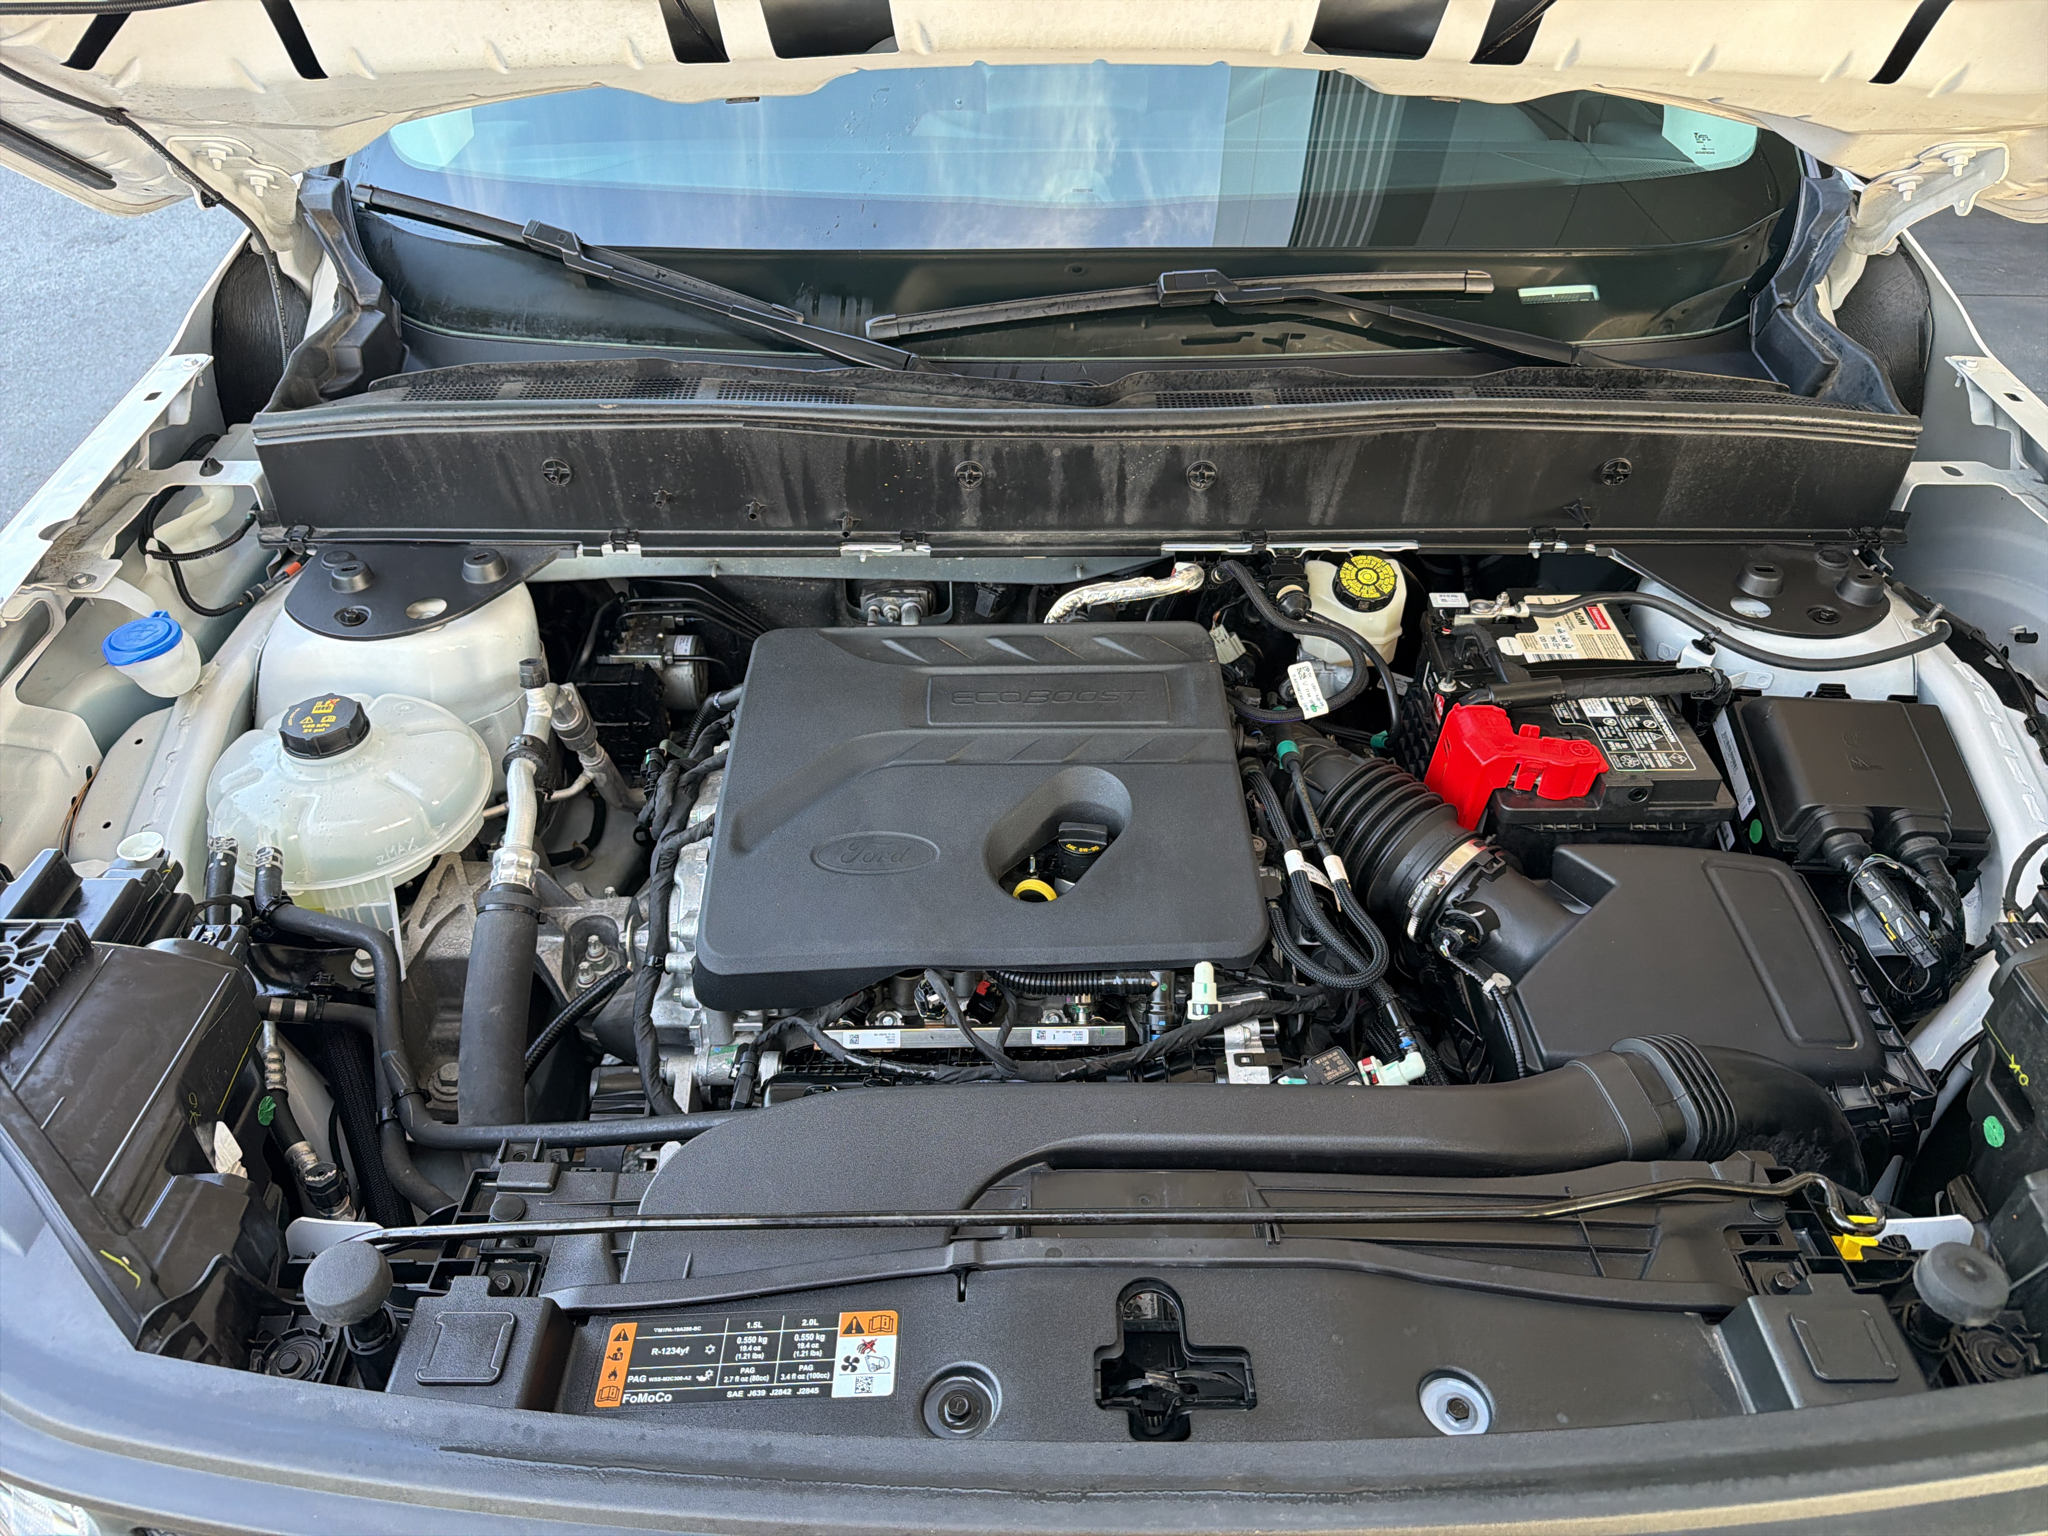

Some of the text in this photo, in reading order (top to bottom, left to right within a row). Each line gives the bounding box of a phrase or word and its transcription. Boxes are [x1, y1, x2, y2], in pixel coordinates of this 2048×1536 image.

[1573, 611, 1588, 626] AGM
[384, 836, 420, 860] MAX
[840, 841, 911, 864] Ford
[746, 1321, 763, 1329] 1.5L
[801, 1318, 819, 1326] 2.0L
[736, 1335, 768, 1345] 0.550 kg
[794, 1333, 826, 1342] 0.550 kg
[651, 1346, 690, 1356] R-1234yf
[793, 1349, 823, 1358] (1.21 lbs)
[735, 1352, 765, 1361] (1.21 lbs)
[627, 1374, 647, 1383] PAG
[749, 1374, 769, 1383] (80cc)
[791, 1372, 797, 1380] fl
[806, 1371, 830, 1380] (100cc)
[726, 1387, 819, 1398] SAE J639 J2842 J2845
[621, 1391, 673, 1405] FoMoCo
